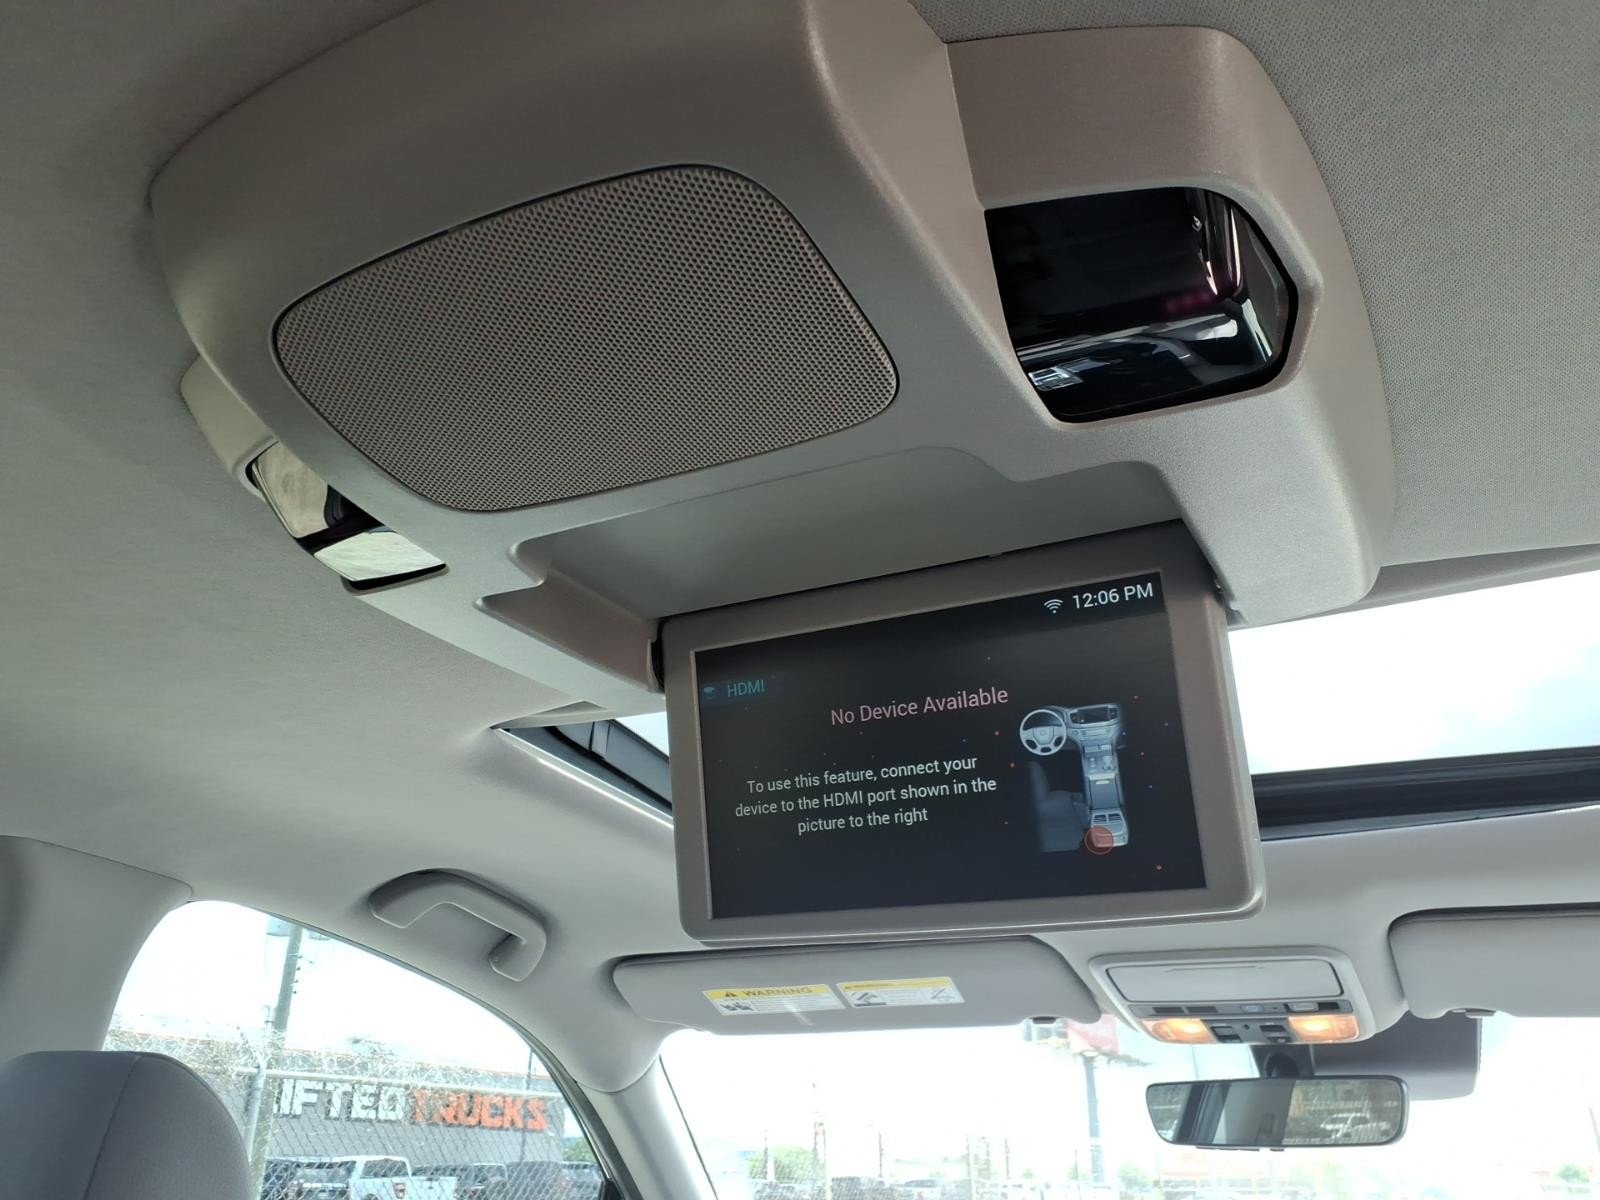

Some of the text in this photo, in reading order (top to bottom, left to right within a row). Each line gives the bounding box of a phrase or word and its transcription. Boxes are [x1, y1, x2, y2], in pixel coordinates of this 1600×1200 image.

[1072, 582, 1154, 609] 12:06 PM
[727, 679, 765, 698] HDMI
[831, 686, 1009, 726] No Device Available
[747, 757, 978, 794] To use this feature, connect your
[735, 777, 998, 817] device to the HDMI port shown in the
[797, 808, 929, 836] picture to the right
[743, 986, 813, 998] WARNING
[411, 1088, 547, 1131] TRUCKS
